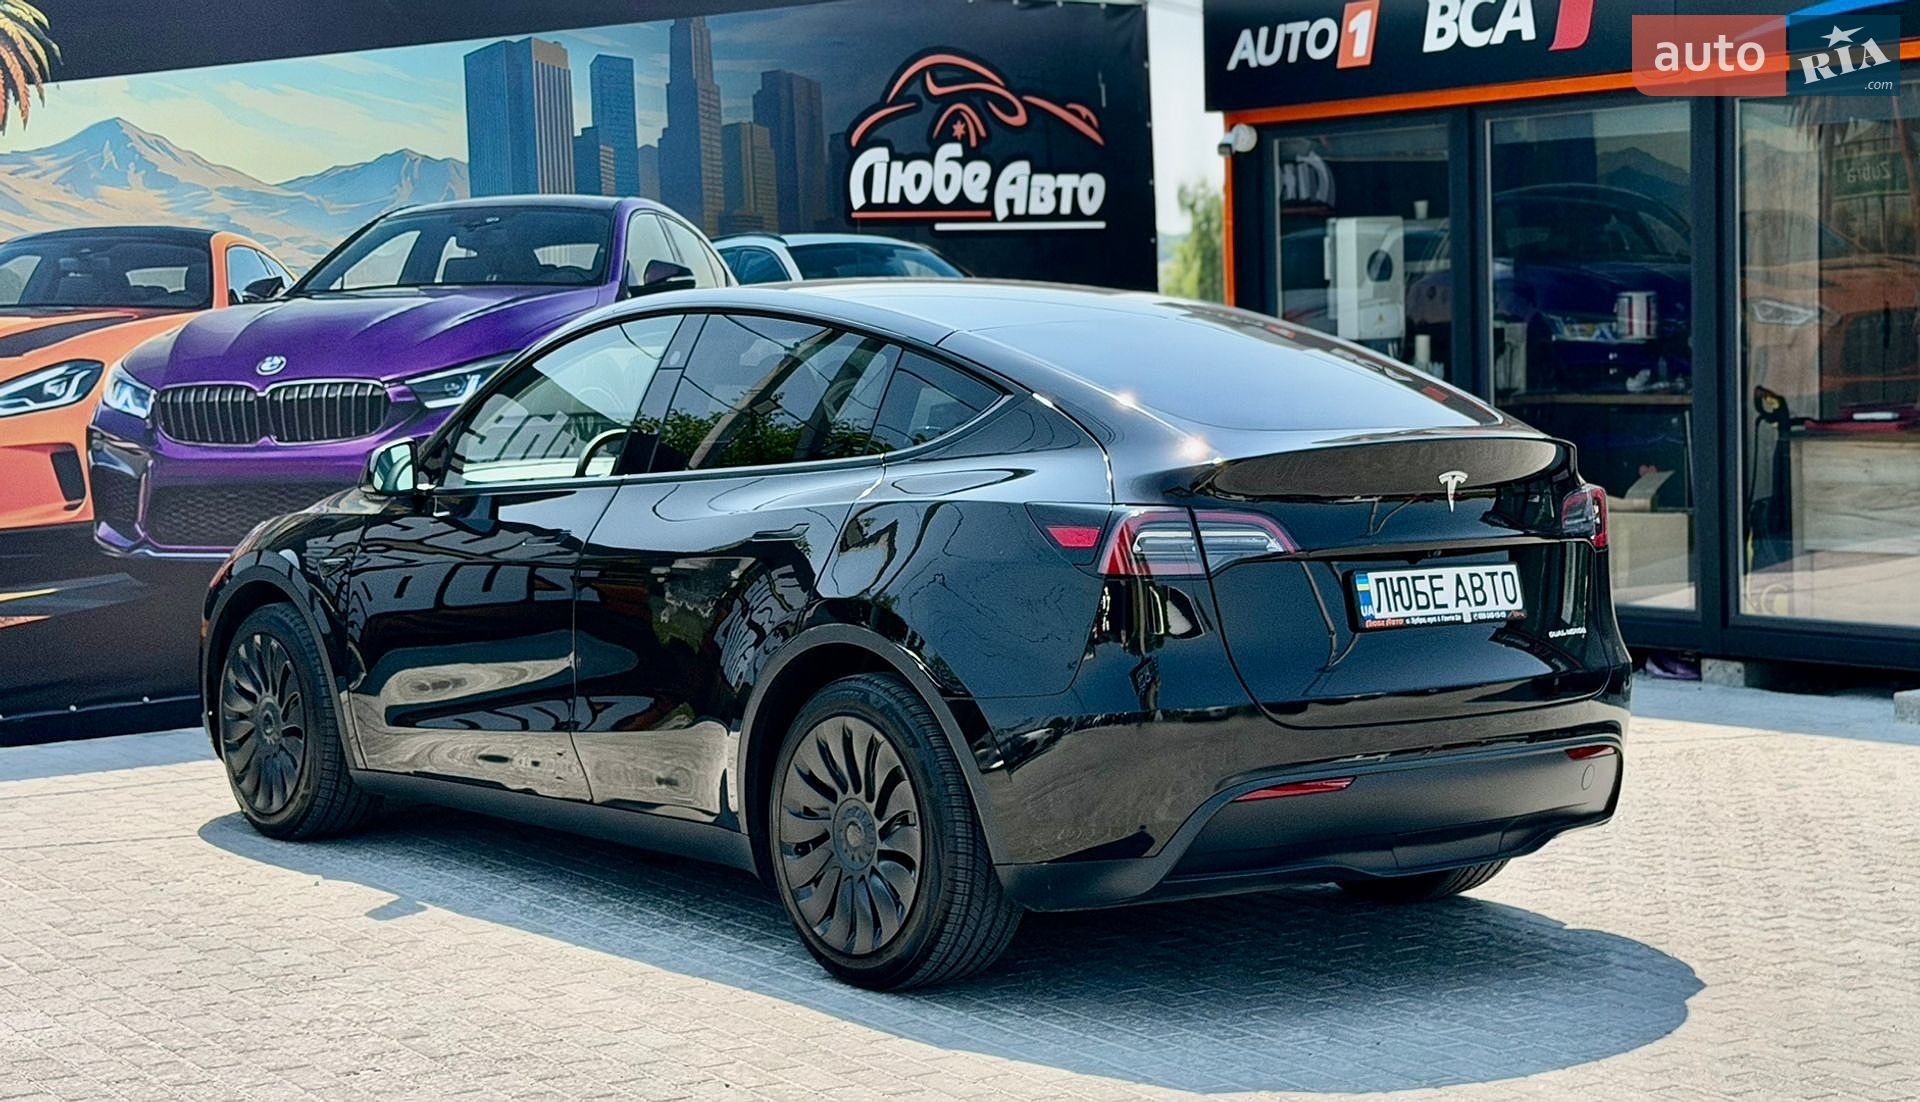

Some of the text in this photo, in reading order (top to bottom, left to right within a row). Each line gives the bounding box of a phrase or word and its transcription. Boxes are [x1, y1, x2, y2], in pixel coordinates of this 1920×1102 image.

[1423, 0, 1537, 53] BCA
[850, 142, 1107, 221] Любе Авто
[1360, 605, 1375, 618] UA
[1374, 571, 1518, 613] ЛЮБЕ АВТО
